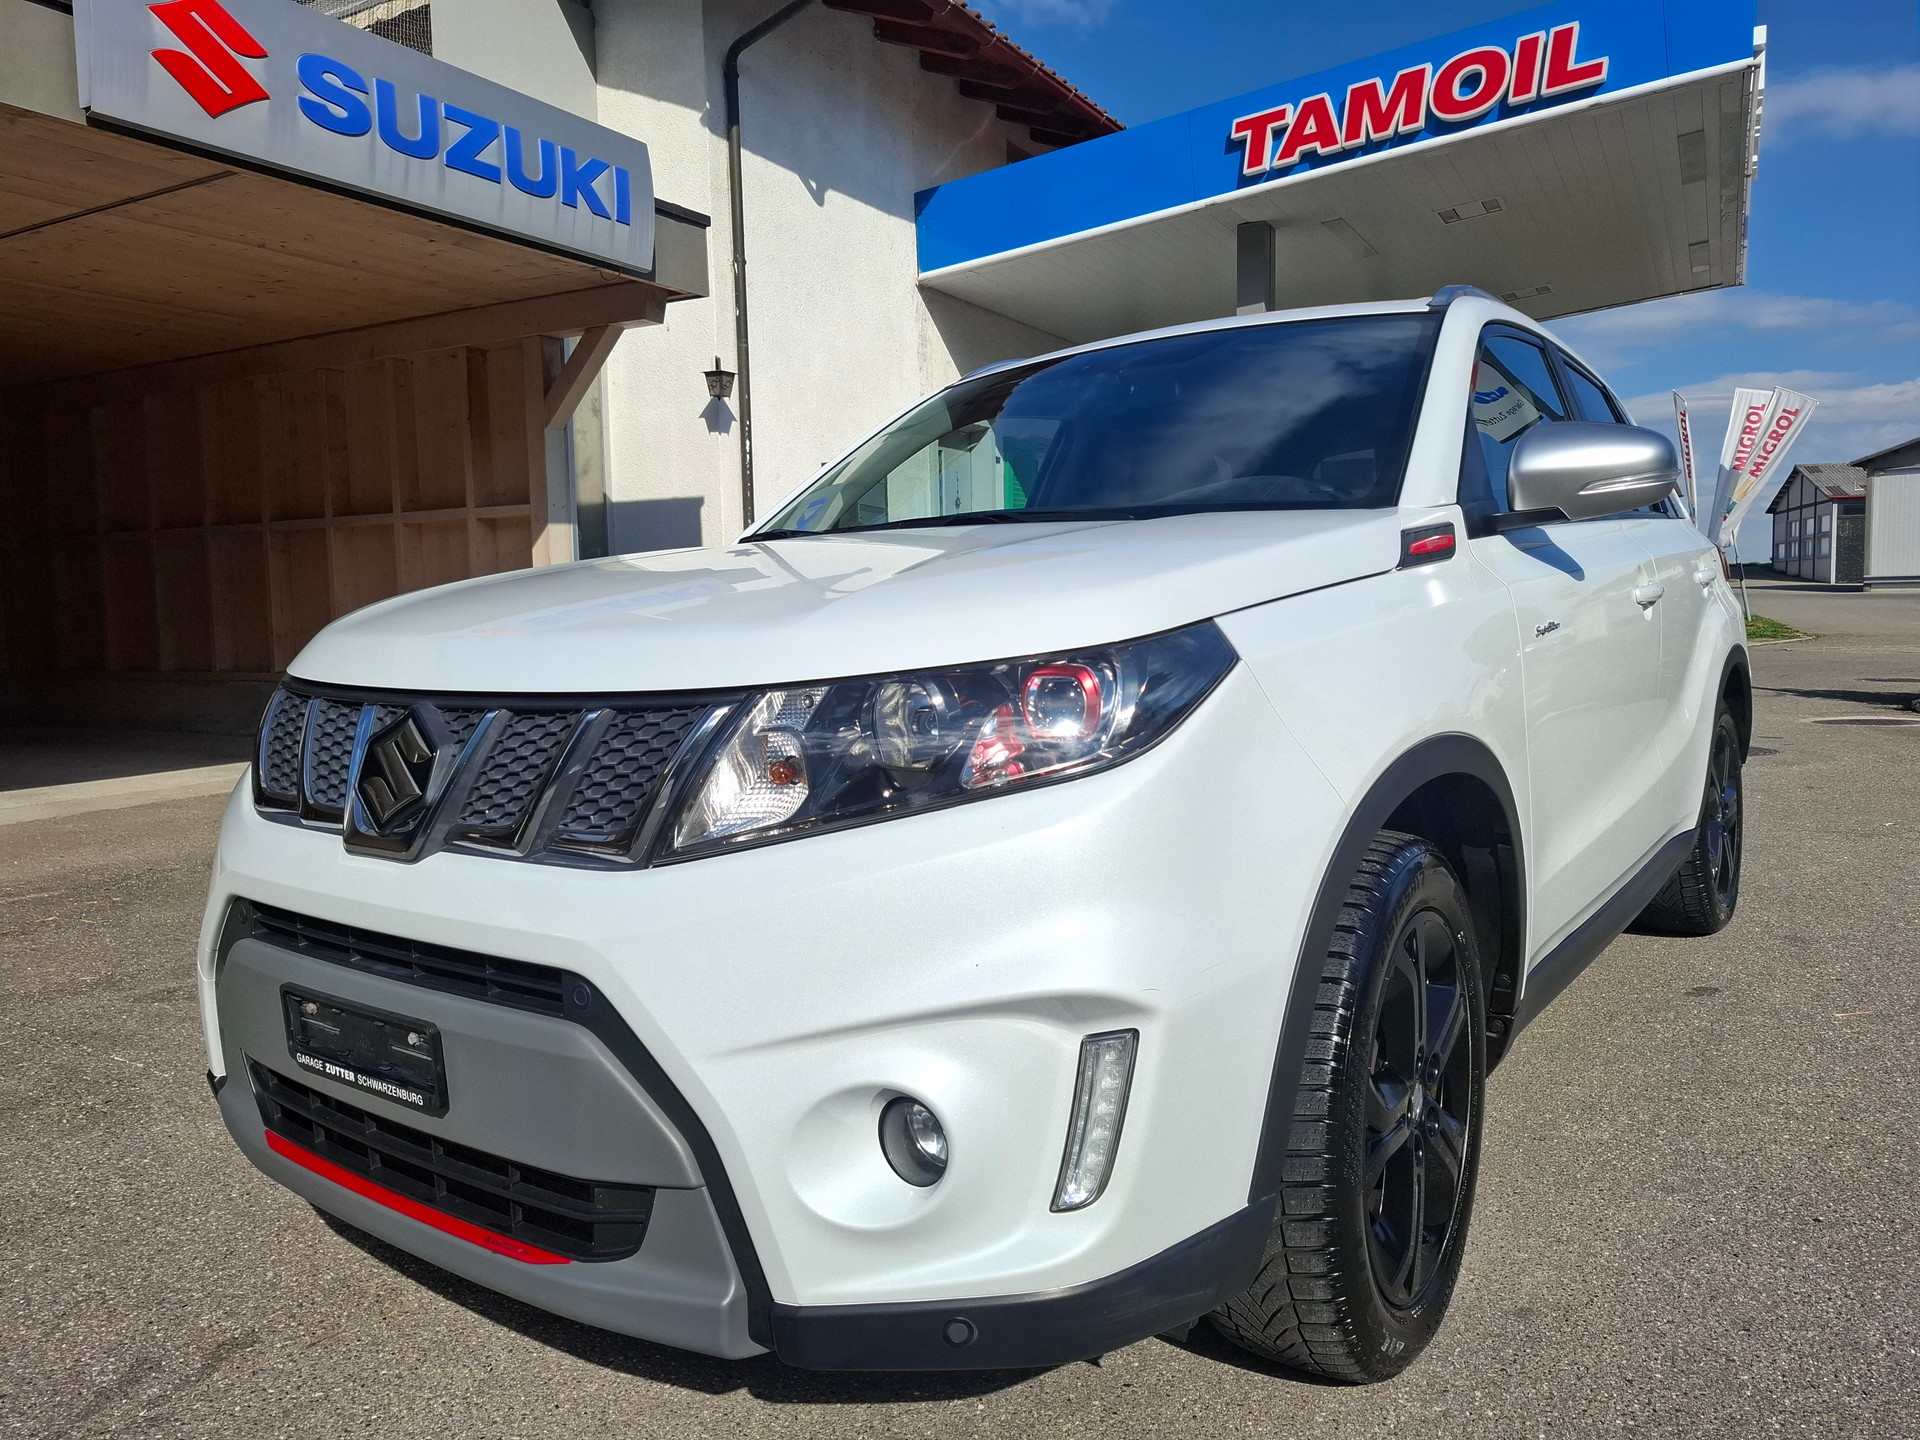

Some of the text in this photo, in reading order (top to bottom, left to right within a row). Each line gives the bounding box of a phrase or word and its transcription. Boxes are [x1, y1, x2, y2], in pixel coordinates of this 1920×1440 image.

[1231, 20, 1609, 177] TAMOIL
[296, 52, 631, 227] SUZUKI
[1732, 403, 1767, 472] MIGROL
[1748, 406, 1800, 478] MIGROL
[296, 1052, 424, 1106] GARAGE ZUTTER SCHWARZENBURG
